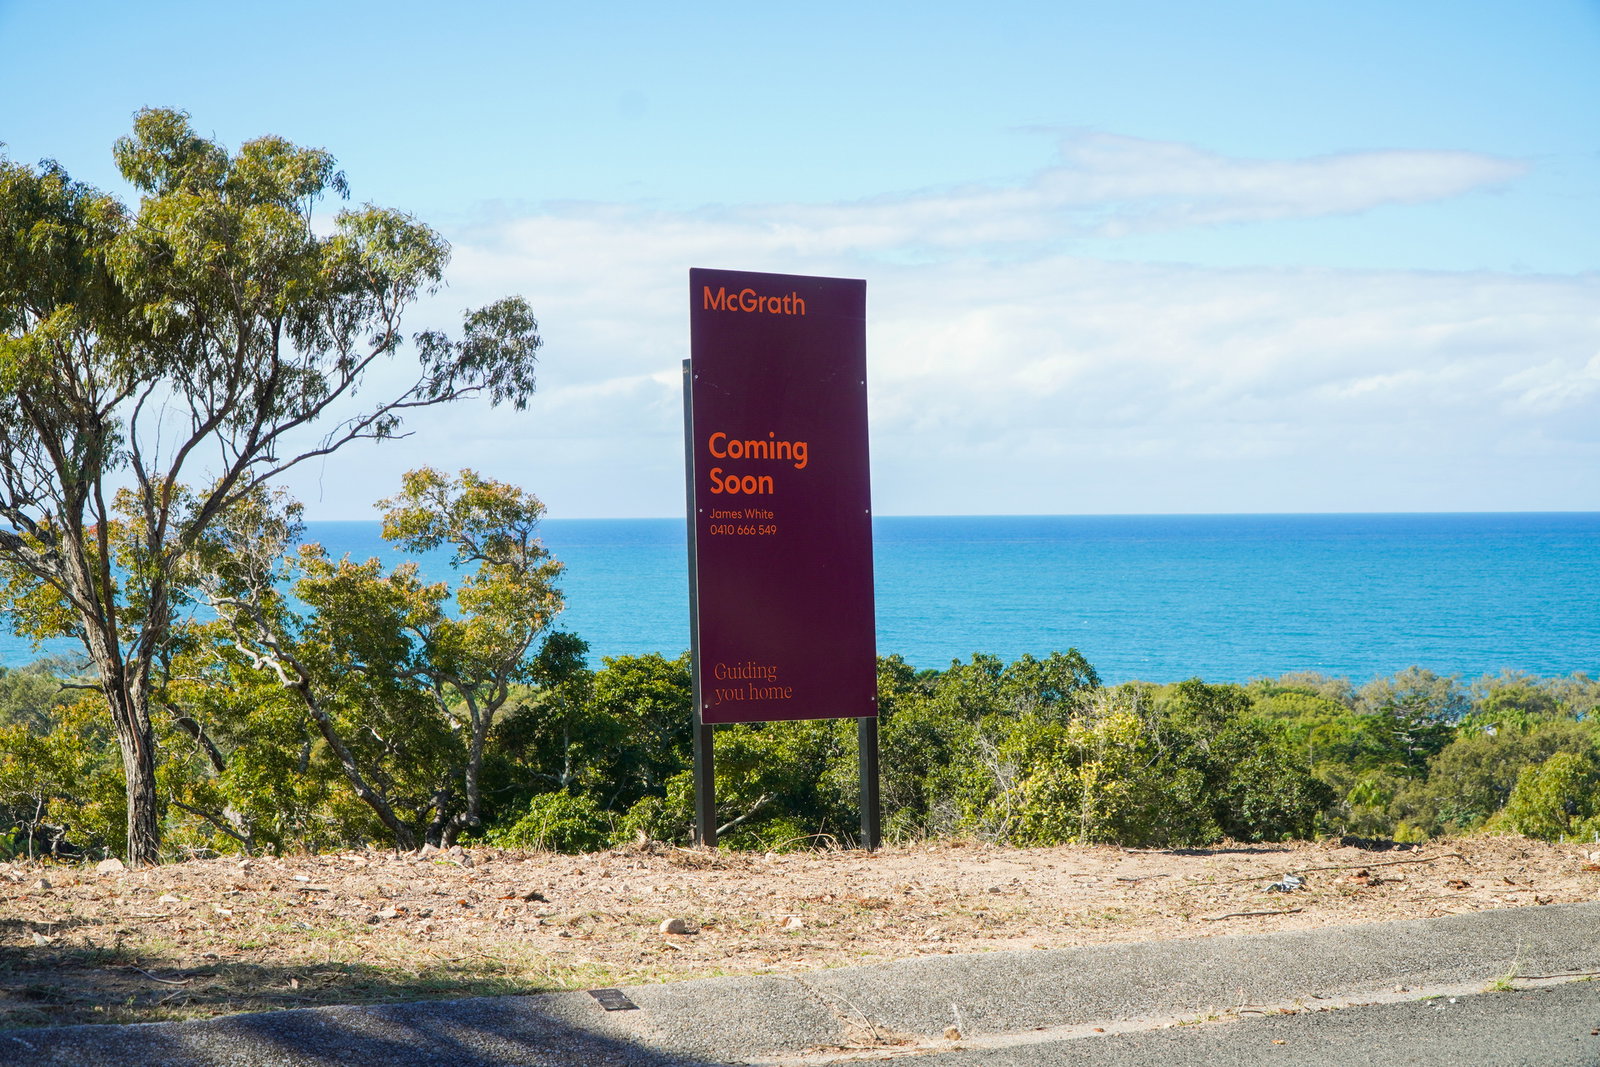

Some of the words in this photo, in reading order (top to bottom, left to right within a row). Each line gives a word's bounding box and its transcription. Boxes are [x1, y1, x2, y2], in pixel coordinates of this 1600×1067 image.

[703, 286, 806, 316] McGrath
[708, 431, 808, 469] Coming
[709, 467, 774, 495] Soon
[709, 508, 743, 519] James
[744, 508, 774, 519] White
[710, 524, 735, 535] 0410
[737, 525, 756, 535] 666
[758, 525, 777, 535] 549
[714, 662, 777, 682] Guiding
[715, 688, 744, 705] you
[749, 683, 793, 700] home
